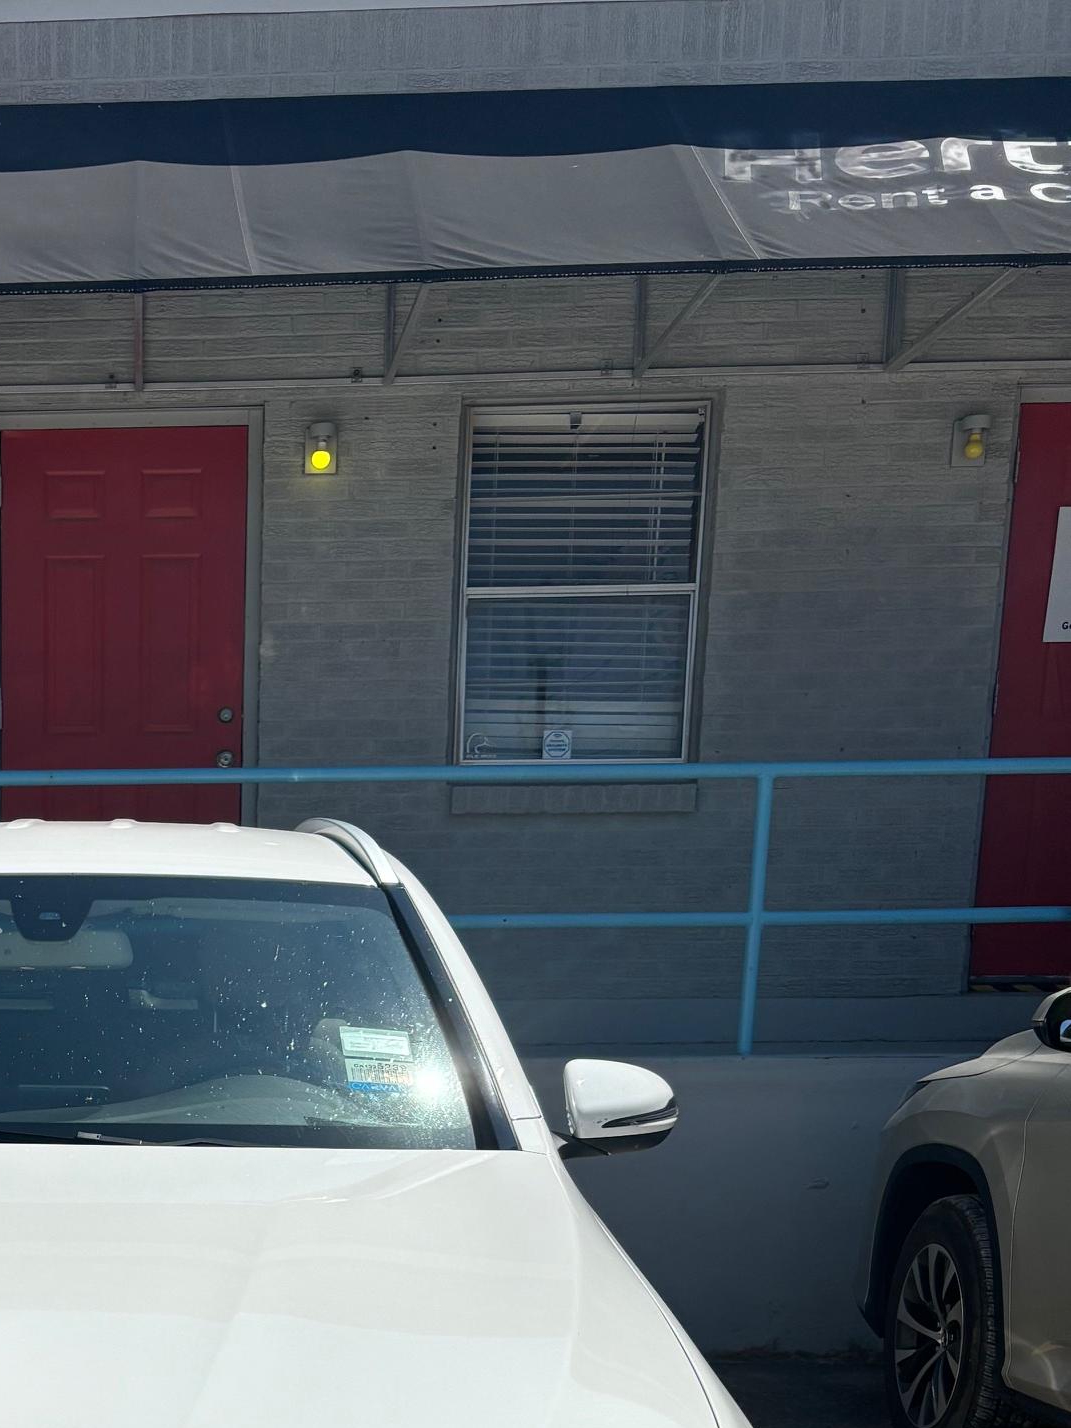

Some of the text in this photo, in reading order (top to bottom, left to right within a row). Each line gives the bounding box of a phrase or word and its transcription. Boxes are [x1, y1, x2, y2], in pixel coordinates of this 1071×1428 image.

[724, 134, 1071, 182] Hert
[788, 185, 948, 210] Rent
[969, 184, 1007, 201] a
